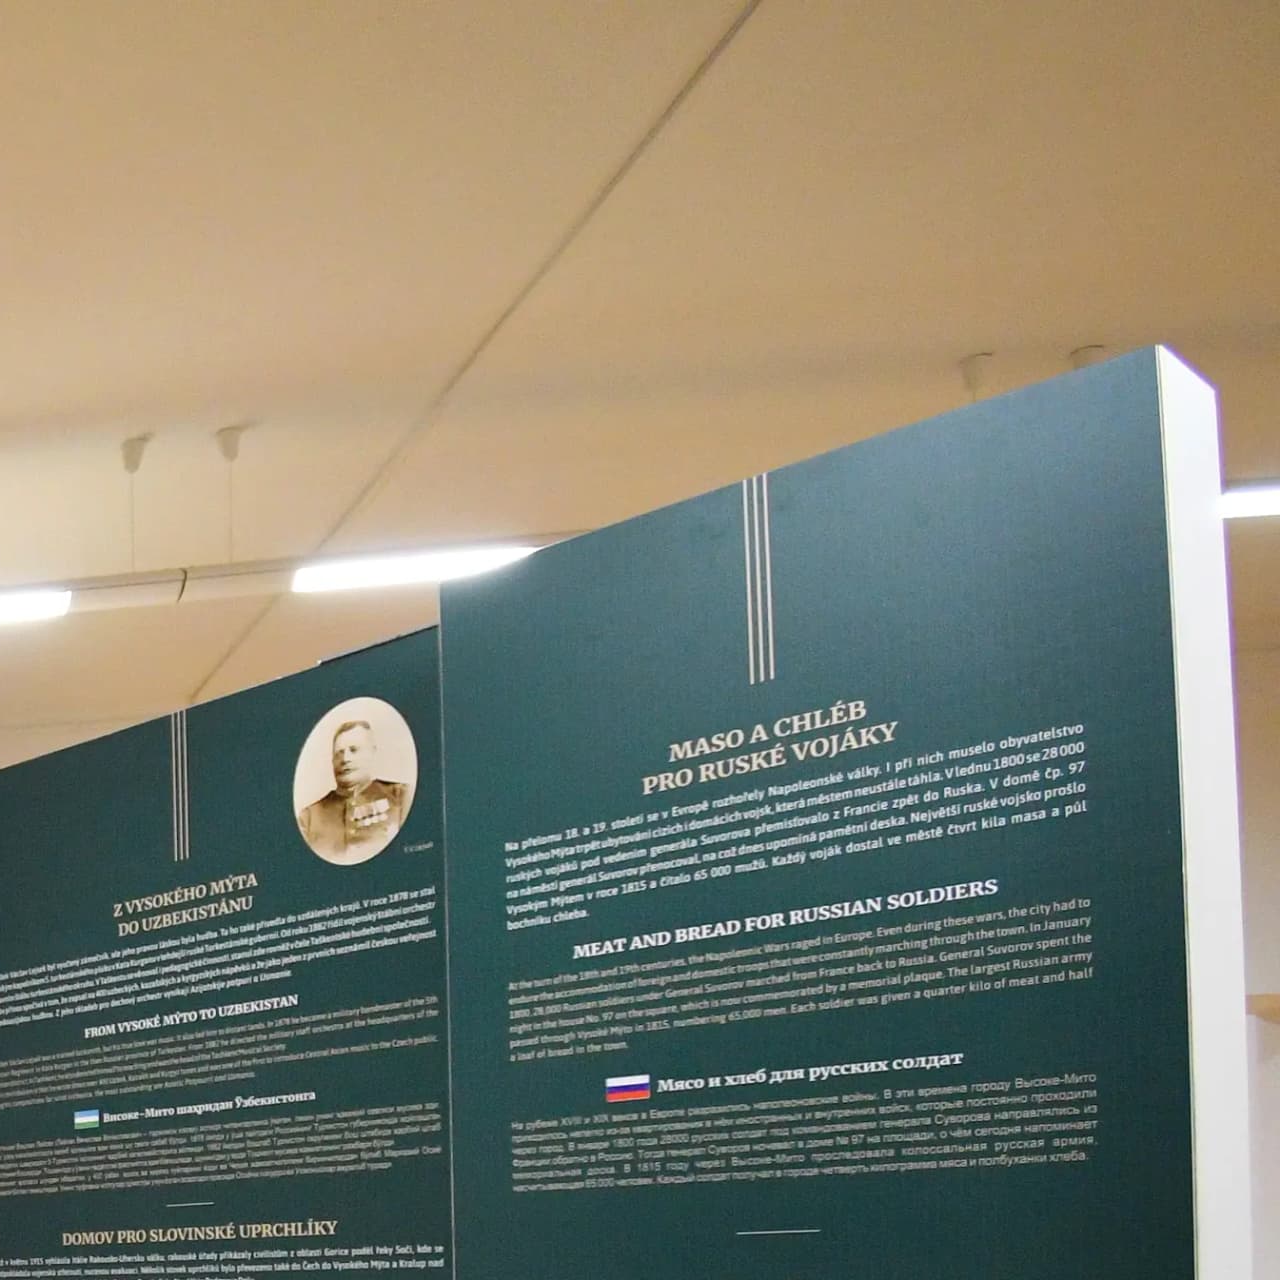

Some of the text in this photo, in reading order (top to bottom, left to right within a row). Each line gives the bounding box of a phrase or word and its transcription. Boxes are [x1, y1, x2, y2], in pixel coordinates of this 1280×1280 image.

[669, 700, 866, 762] MASO A CHLÉB
[895, 758, 912, 773] při
[917, 751, 944, 765] nich
[949, 741, 995, 759] muselo
[1000, 725, 1083, 749] obyvatelstvo
[643, 721, 897, 794] PRO RUSKÉ VOJÁKY
[923, 790, 939, 802] do
[944, 783, 985, 798] Ruska.
[1003, 770, 1040, 787] domě
[1045, 768, 1064, 780] čp.
[1069, 761, 1085, 774] 97
[888, 836, 901, 845] ve
[906, 826, 943, 842] městě
[947, 821, 976, 835] čtvrt
[982, 816, 1006, 829] kila
[1011, 810, 1046, 824] masa
[1065, 800, 1087, 817] půl
[114, 873, 257, 917] Z VYSOKÉHO MÝTA
[119, 896, 252, 936] DO UZBEKISTÁNU
[573, 879, 998, 959] MEAT AND BREAD FOR RUSSIAN SOLDIERS
[969, 967, 1093, 991] kilo of meat and half
[85, 994, 298, 1038] FROM VYSOKÉ MÝTO TO UZBEKISTAN
[657, 1053, 963, 1092] Мясо и хлеб для русских солдат
[63, 1219, 337, 1245] DOMOV PRO SLOVINSKÉ UPRCHLÍKY
